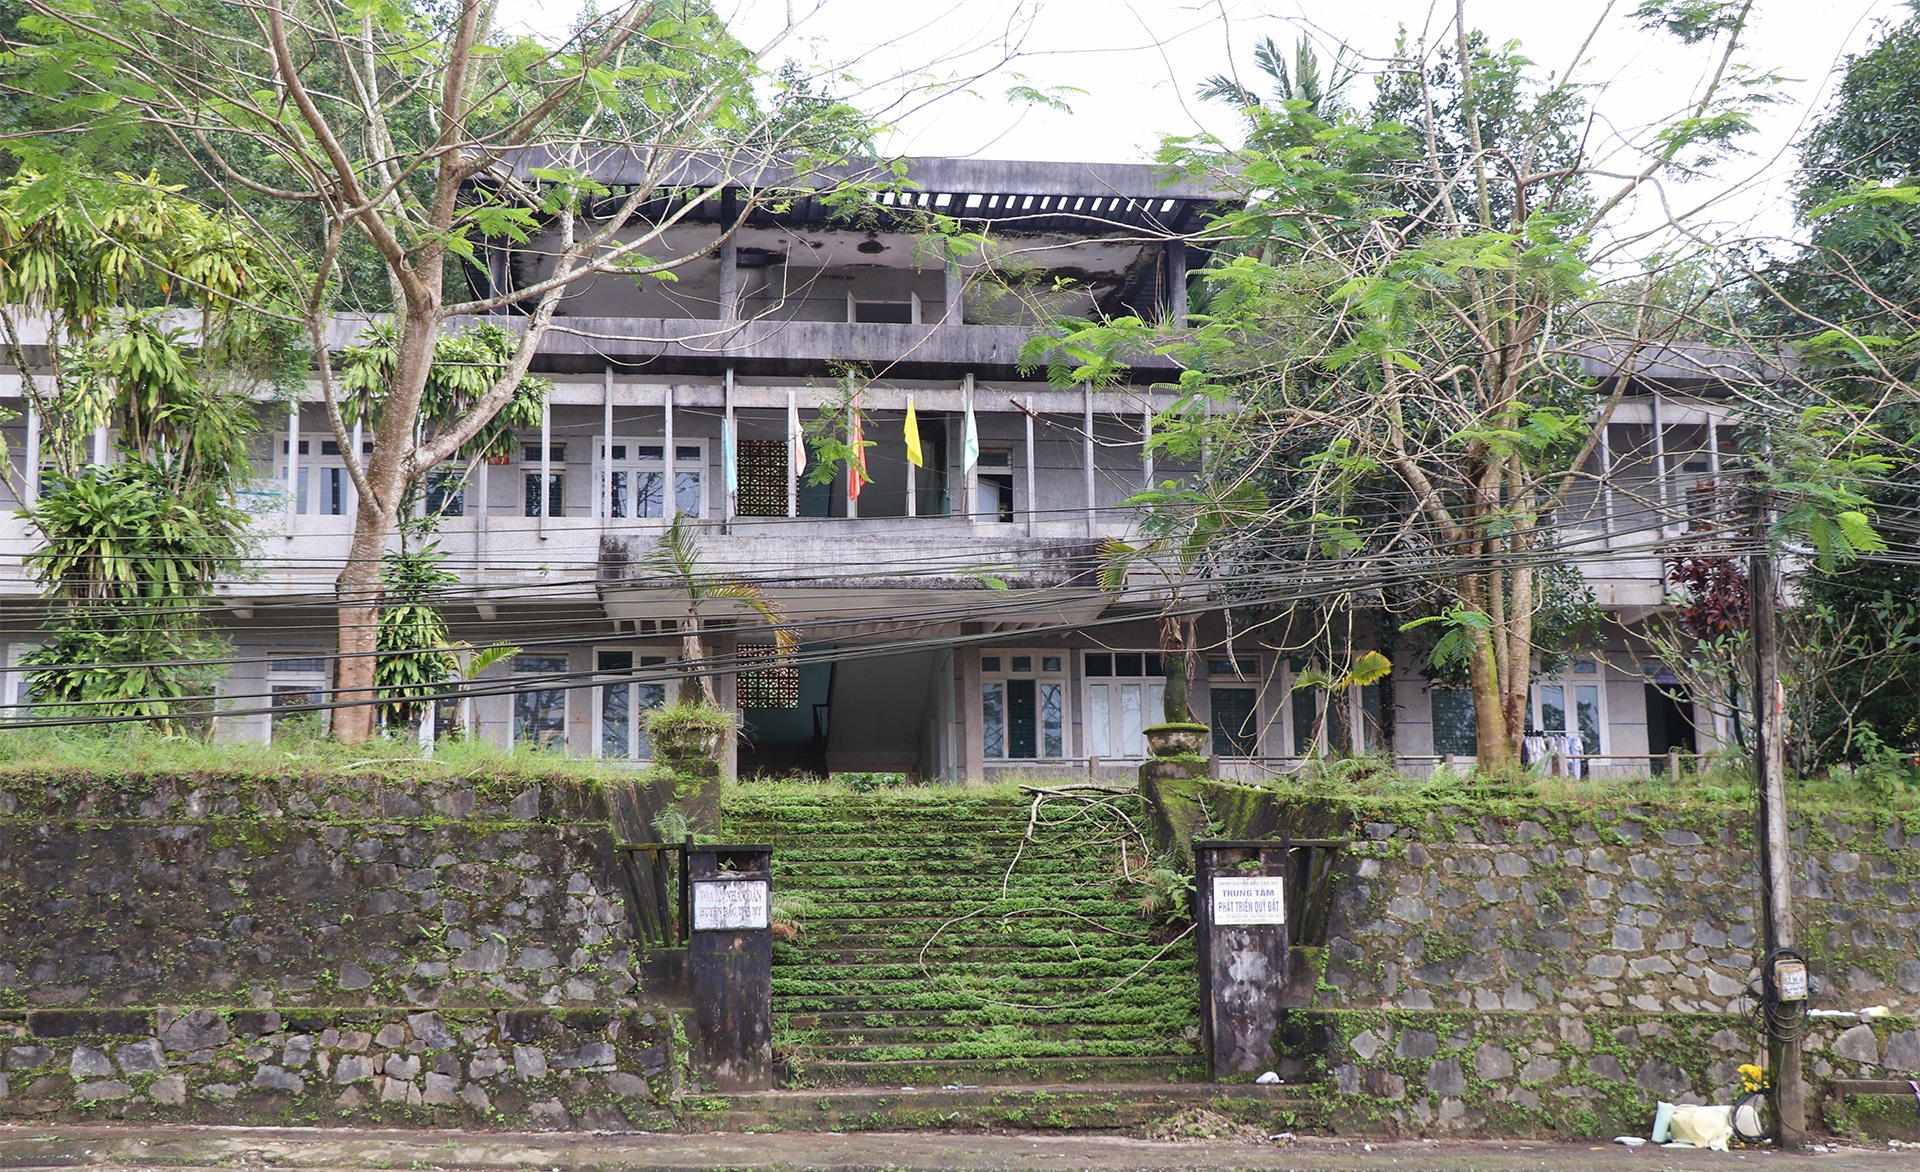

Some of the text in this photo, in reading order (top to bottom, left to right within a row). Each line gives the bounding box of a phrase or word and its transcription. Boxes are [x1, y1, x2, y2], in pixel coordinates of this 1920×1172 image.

[1222, 888, 1275, 897] TRUNG TÂM
[1218, 898, 1279, 914] PHÁT TRIỂN QUỸ ĐẤT
